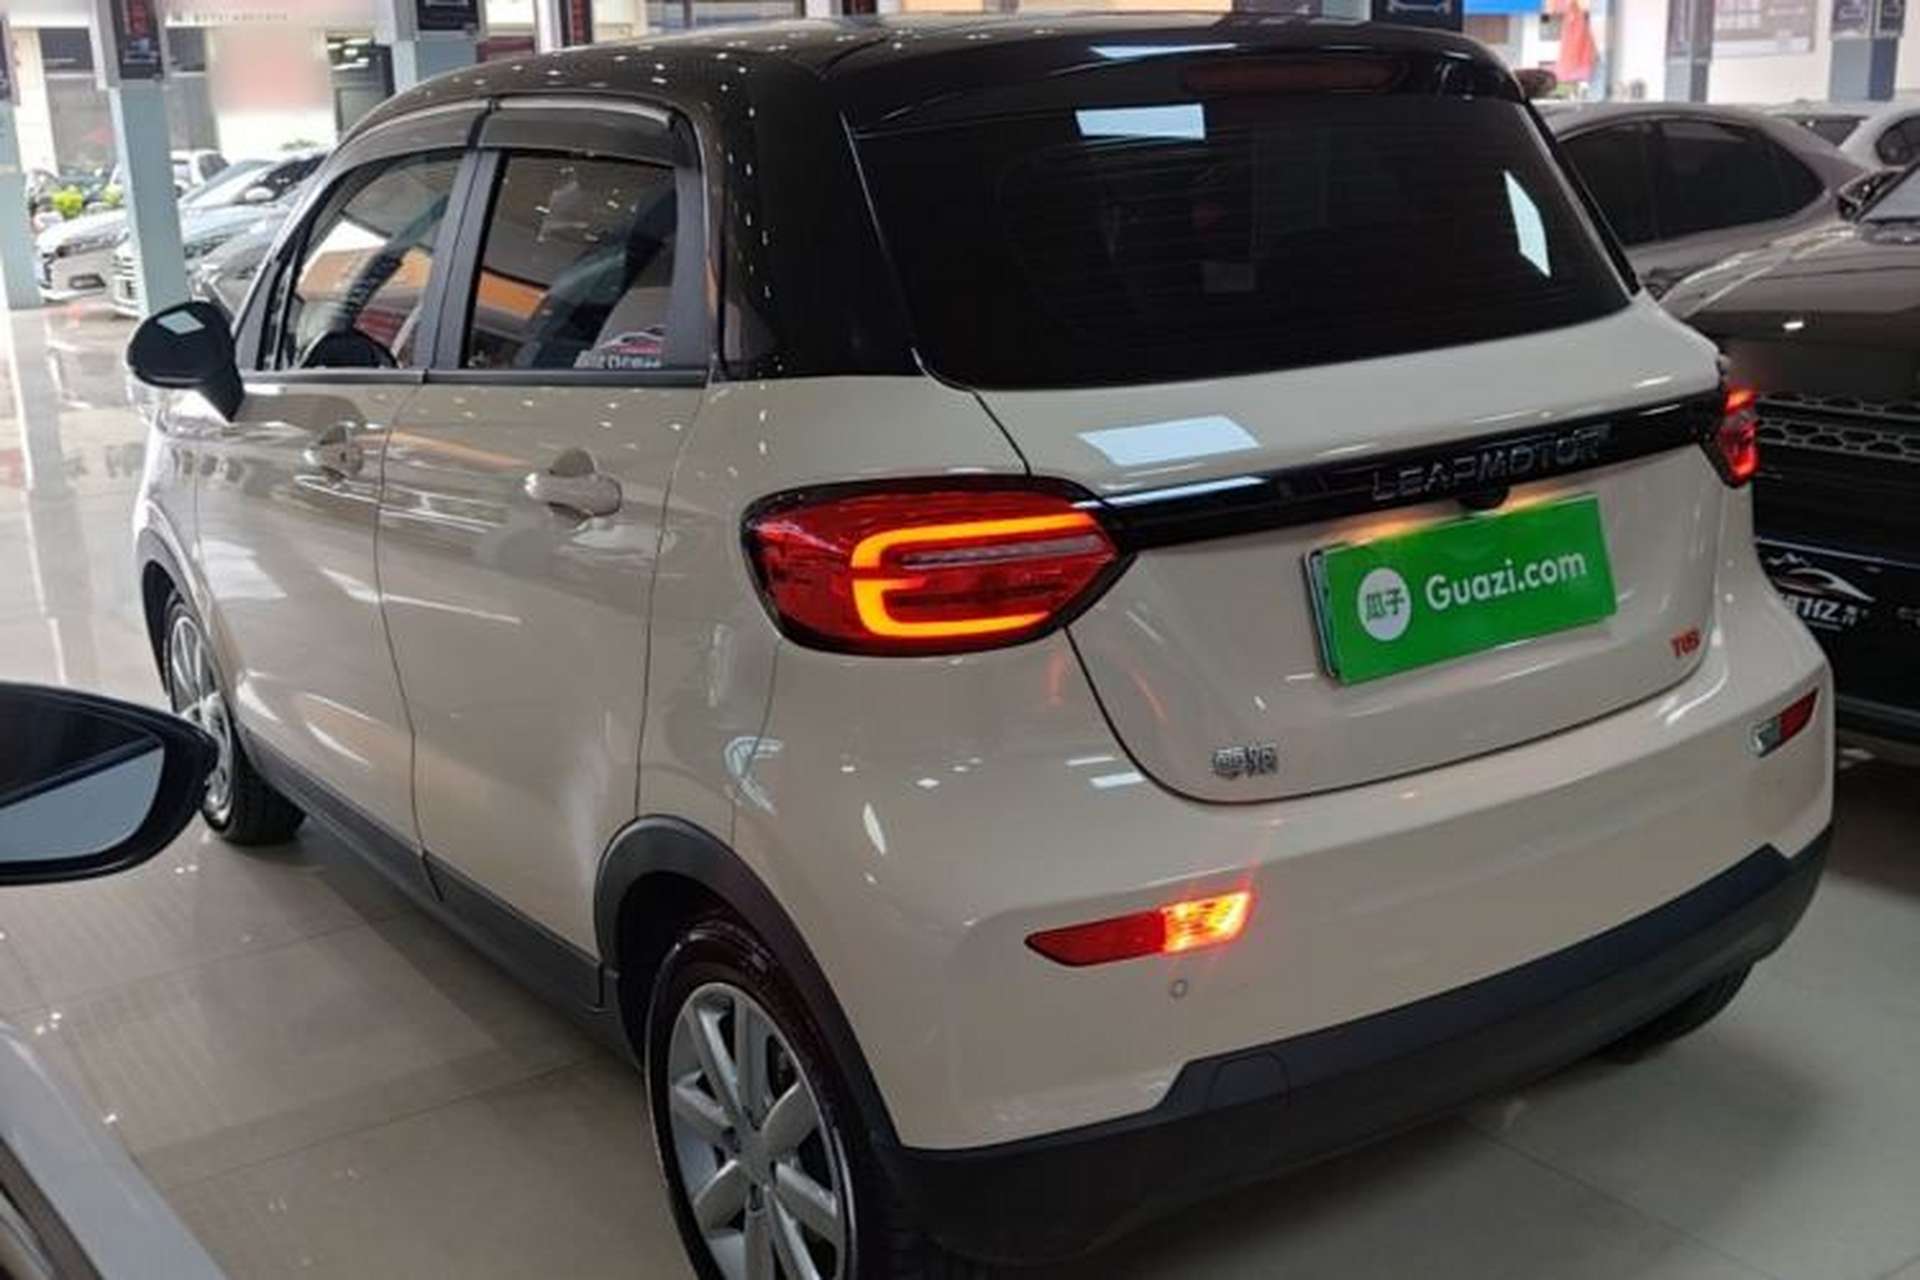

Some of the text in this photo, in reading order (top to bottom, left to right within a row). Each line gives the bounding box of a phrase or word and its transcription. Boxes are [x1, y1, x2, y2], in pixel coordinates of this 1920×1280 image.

[1373, 424, 1610, 500] LEAPMOTOR
[1366, 588, 1405, 621] 瓜子
[1425, 552, 1587, 611] Guazi.com
